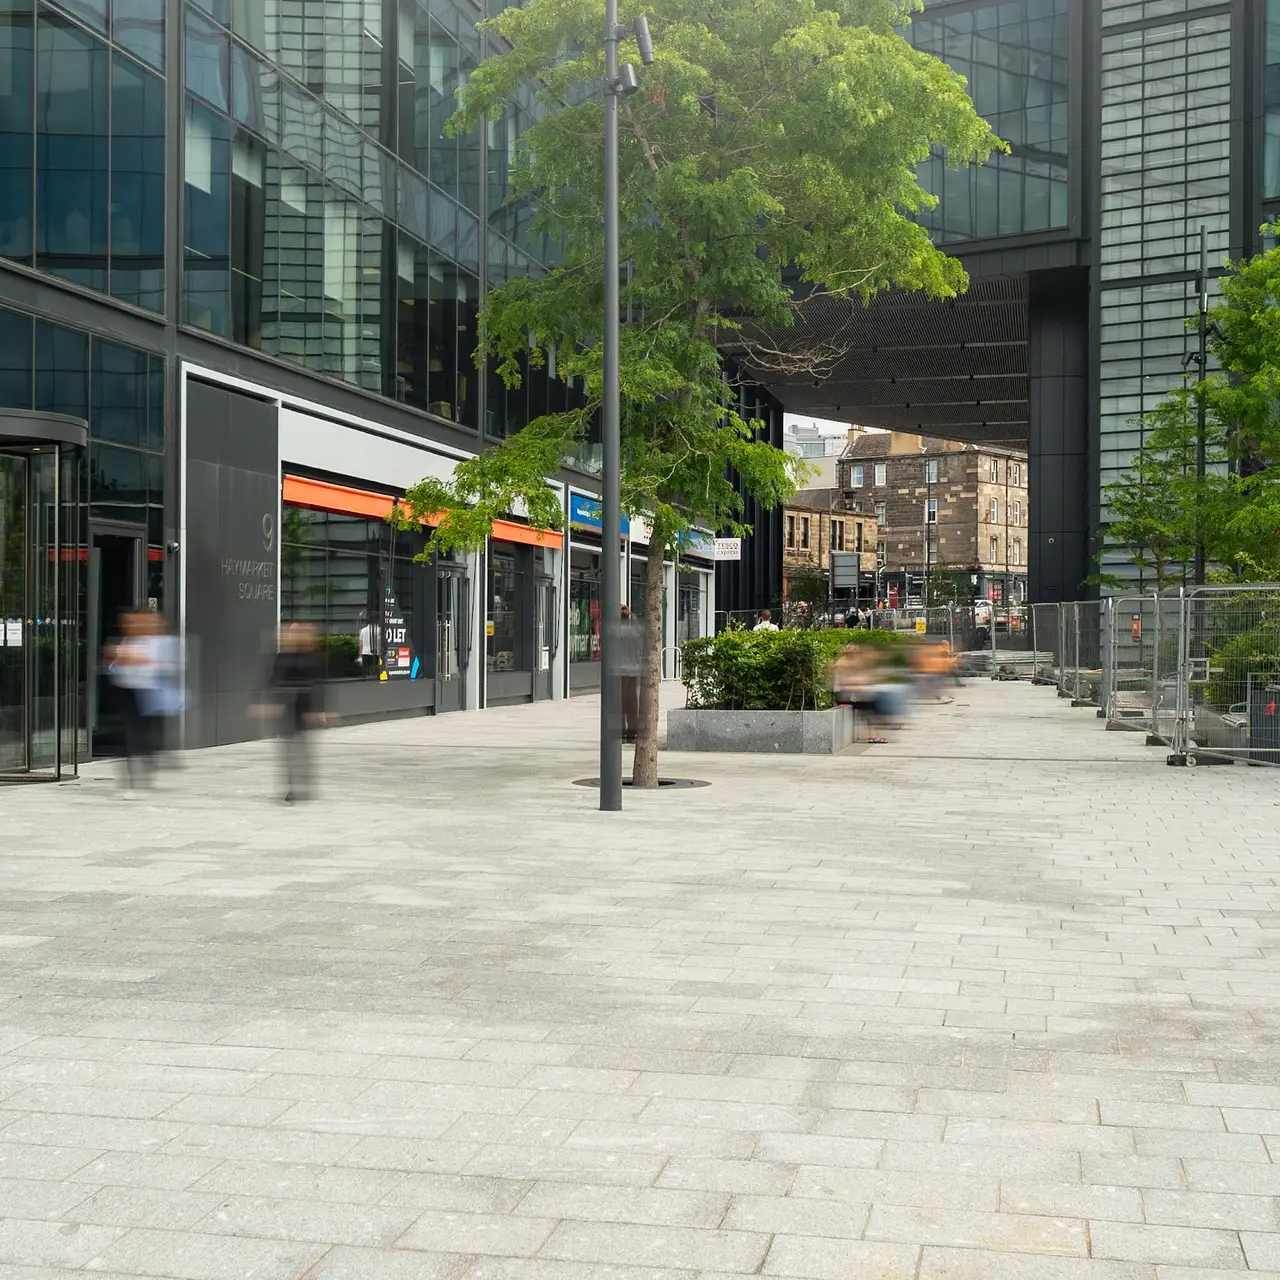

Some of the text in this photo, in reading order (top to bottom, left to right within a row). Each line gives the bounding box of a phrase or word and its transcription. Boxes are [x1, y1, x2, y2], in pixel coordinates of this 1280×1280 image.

[262, 512, 274, 552] 9
[221, 557, 274, 579] HAYMARKET
[239, 582, 274, 600] SQUARE
[393, 628, 406, 643] LET
